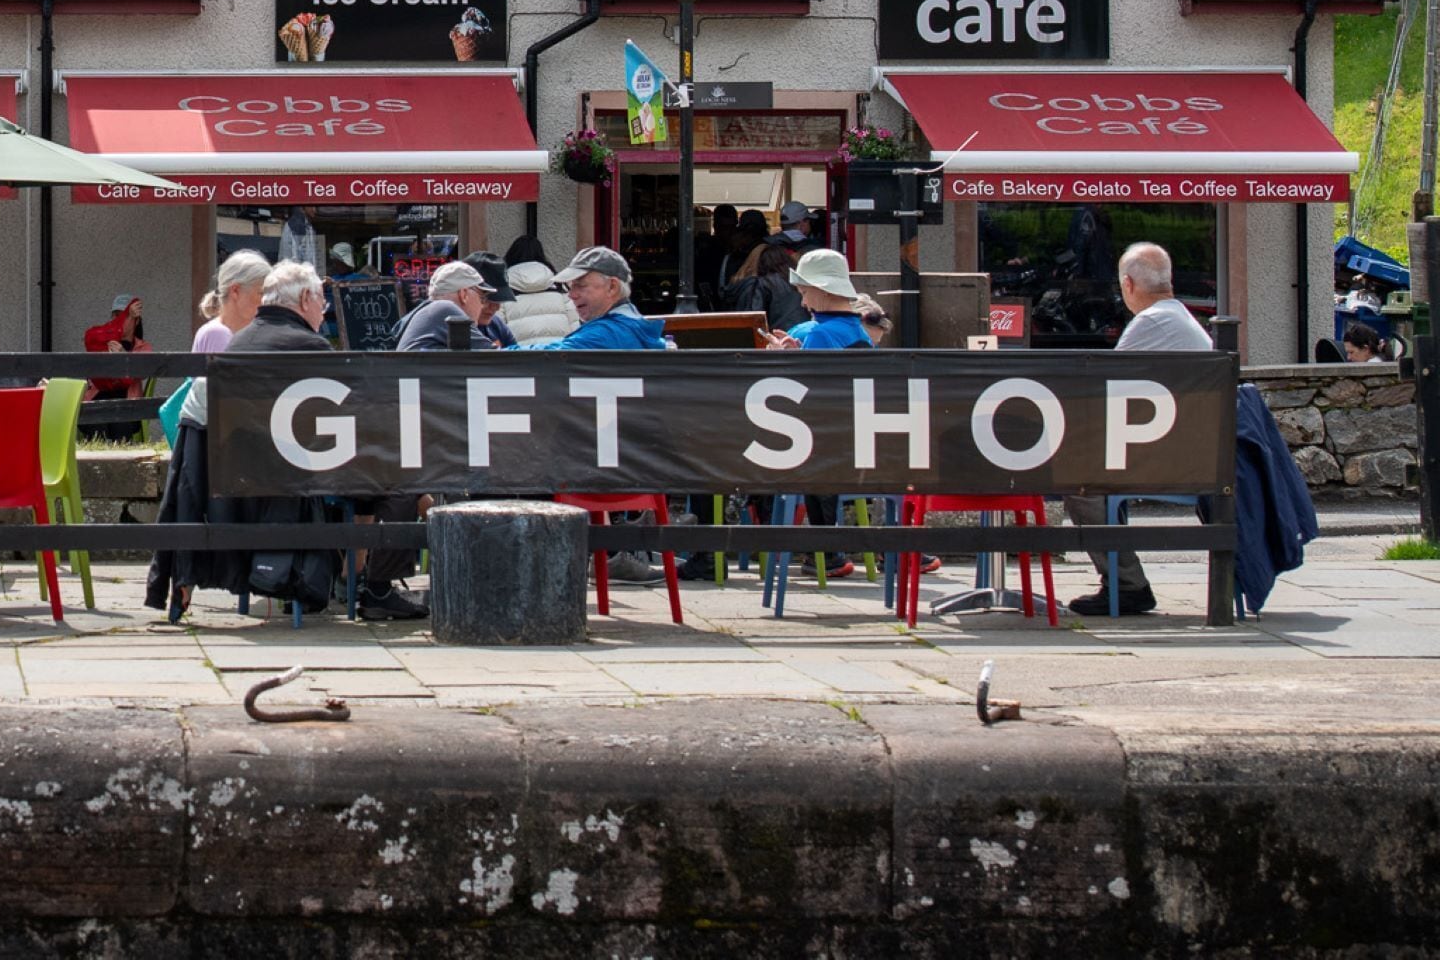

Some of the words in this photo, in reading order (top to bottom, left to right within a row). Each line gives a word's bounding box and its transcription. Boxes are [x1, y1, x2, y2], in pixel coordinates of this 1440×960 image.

[178, 95, 412, 114] Cobbs
[988, 92, 1224, 111] Cobbs
[214, 118, 386, 137] Café
[1036, 116, 1209, 135] Café
[230, 181, 290, 198] Gelato
[304, 181, 336, 197] Tea
[350, 180, 409, 196] Coffee
[423, 179, 513, 198] Takeaway
[952, 180, 995, 196] Cafe
[1003, 180, 1064, 199] Bakery
[1072, 180, 1131, 197] Gelato
[1139, 180, 1171, 196] Tea
[1180, 180, 1237, 197] Coffee
[1245, 180, 1334, 200] Takeaway
[977, 340, 988, 350] 7
[270, 376, 645, 471] GIFT
[742, 376, 1177, 471] SHOP
